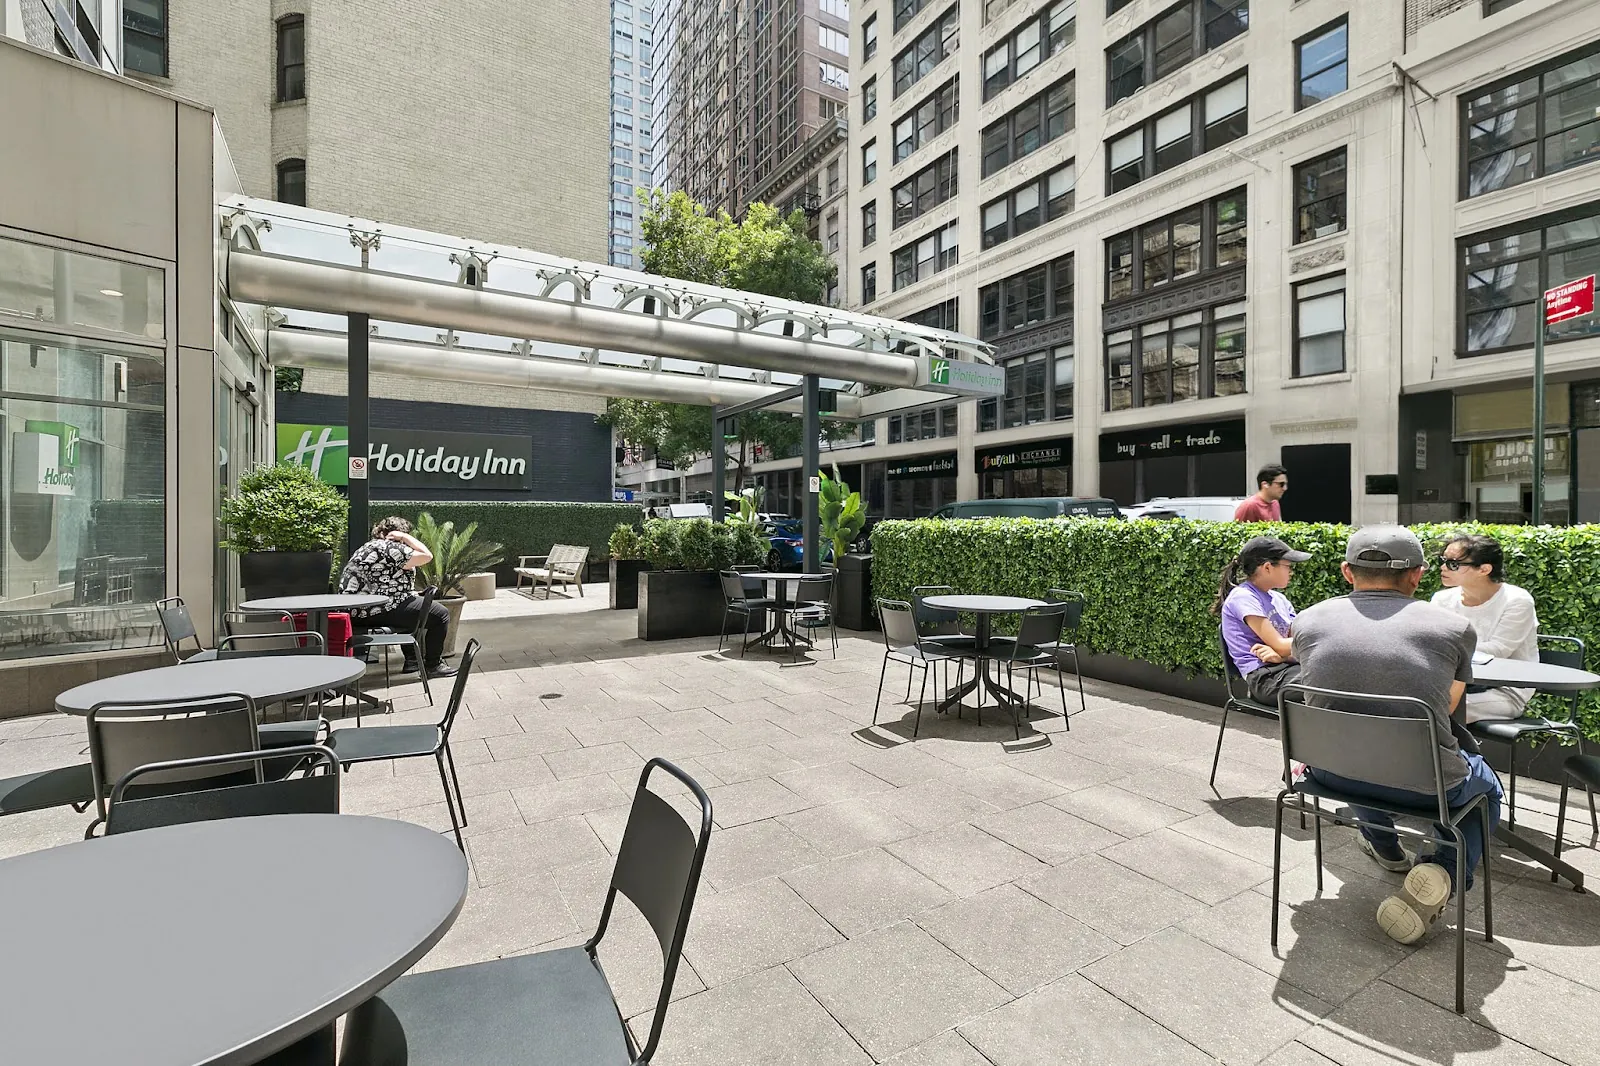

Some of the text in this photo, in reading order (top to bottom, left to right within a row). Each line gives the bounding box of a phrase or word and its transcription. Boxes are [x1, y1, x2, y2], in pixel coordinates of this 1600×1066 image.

[1547, 281, 1588, 301] NO STANDING
[952, 367, 986, 387] Holiday
[1117, 430, 1221, 456] buy sell trade
[368, 442, 526, 481] Holiday Inn
